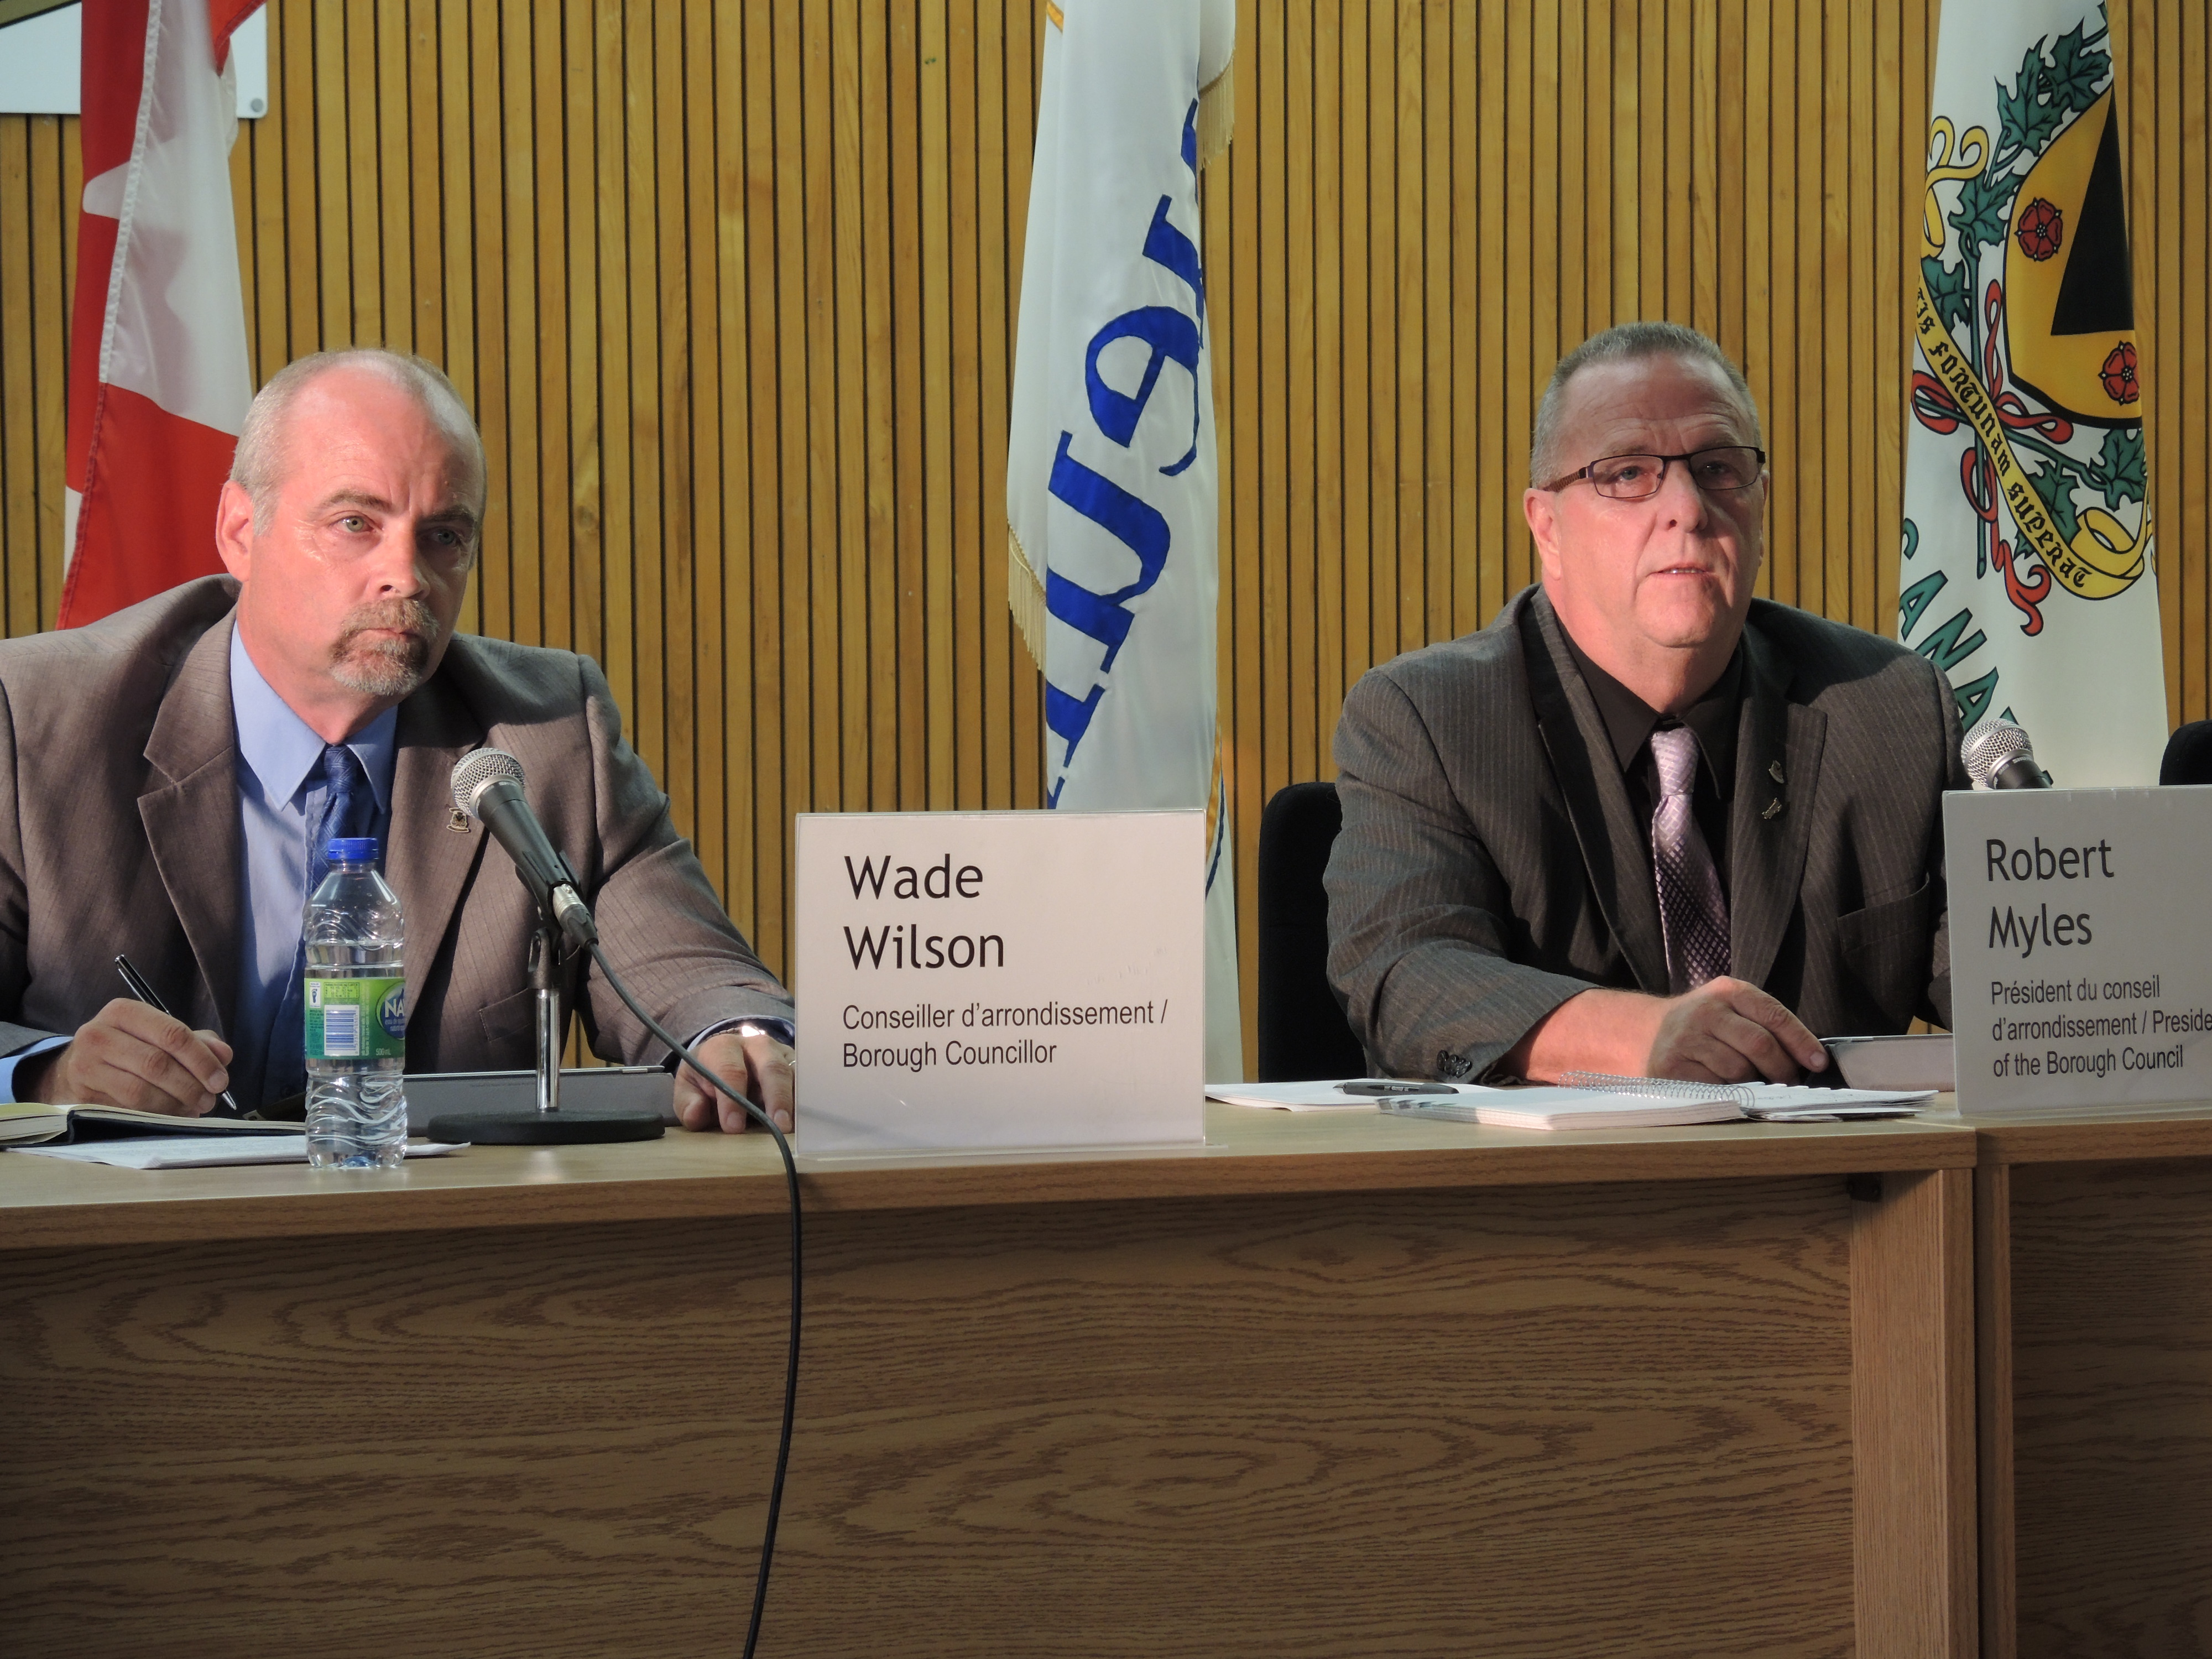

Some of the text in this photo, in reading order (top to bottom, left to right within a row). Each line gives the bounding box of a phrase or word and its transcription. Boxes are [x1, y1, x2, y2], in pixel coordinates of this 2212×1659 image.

[1986, 837, 2115, 881] Robert
[844, 853, 983, 900] Wade
[843, 924, 1004, 970] Wilson
[1989, 902, 2093, 959] Myles
[1991, 974, 2160, 1005] Président du conseil
[384, 998, 405, 1018] NA
[843, 999, 1168, 1030] Conseiller d'arrondissement /
[1992, 1008, 2212, 1041] d'arrondissement / Preside
[843, 1039, 1057, 1073] Borough Councillor
[1993, 1044, 2183, 1078] of the Borough Council
